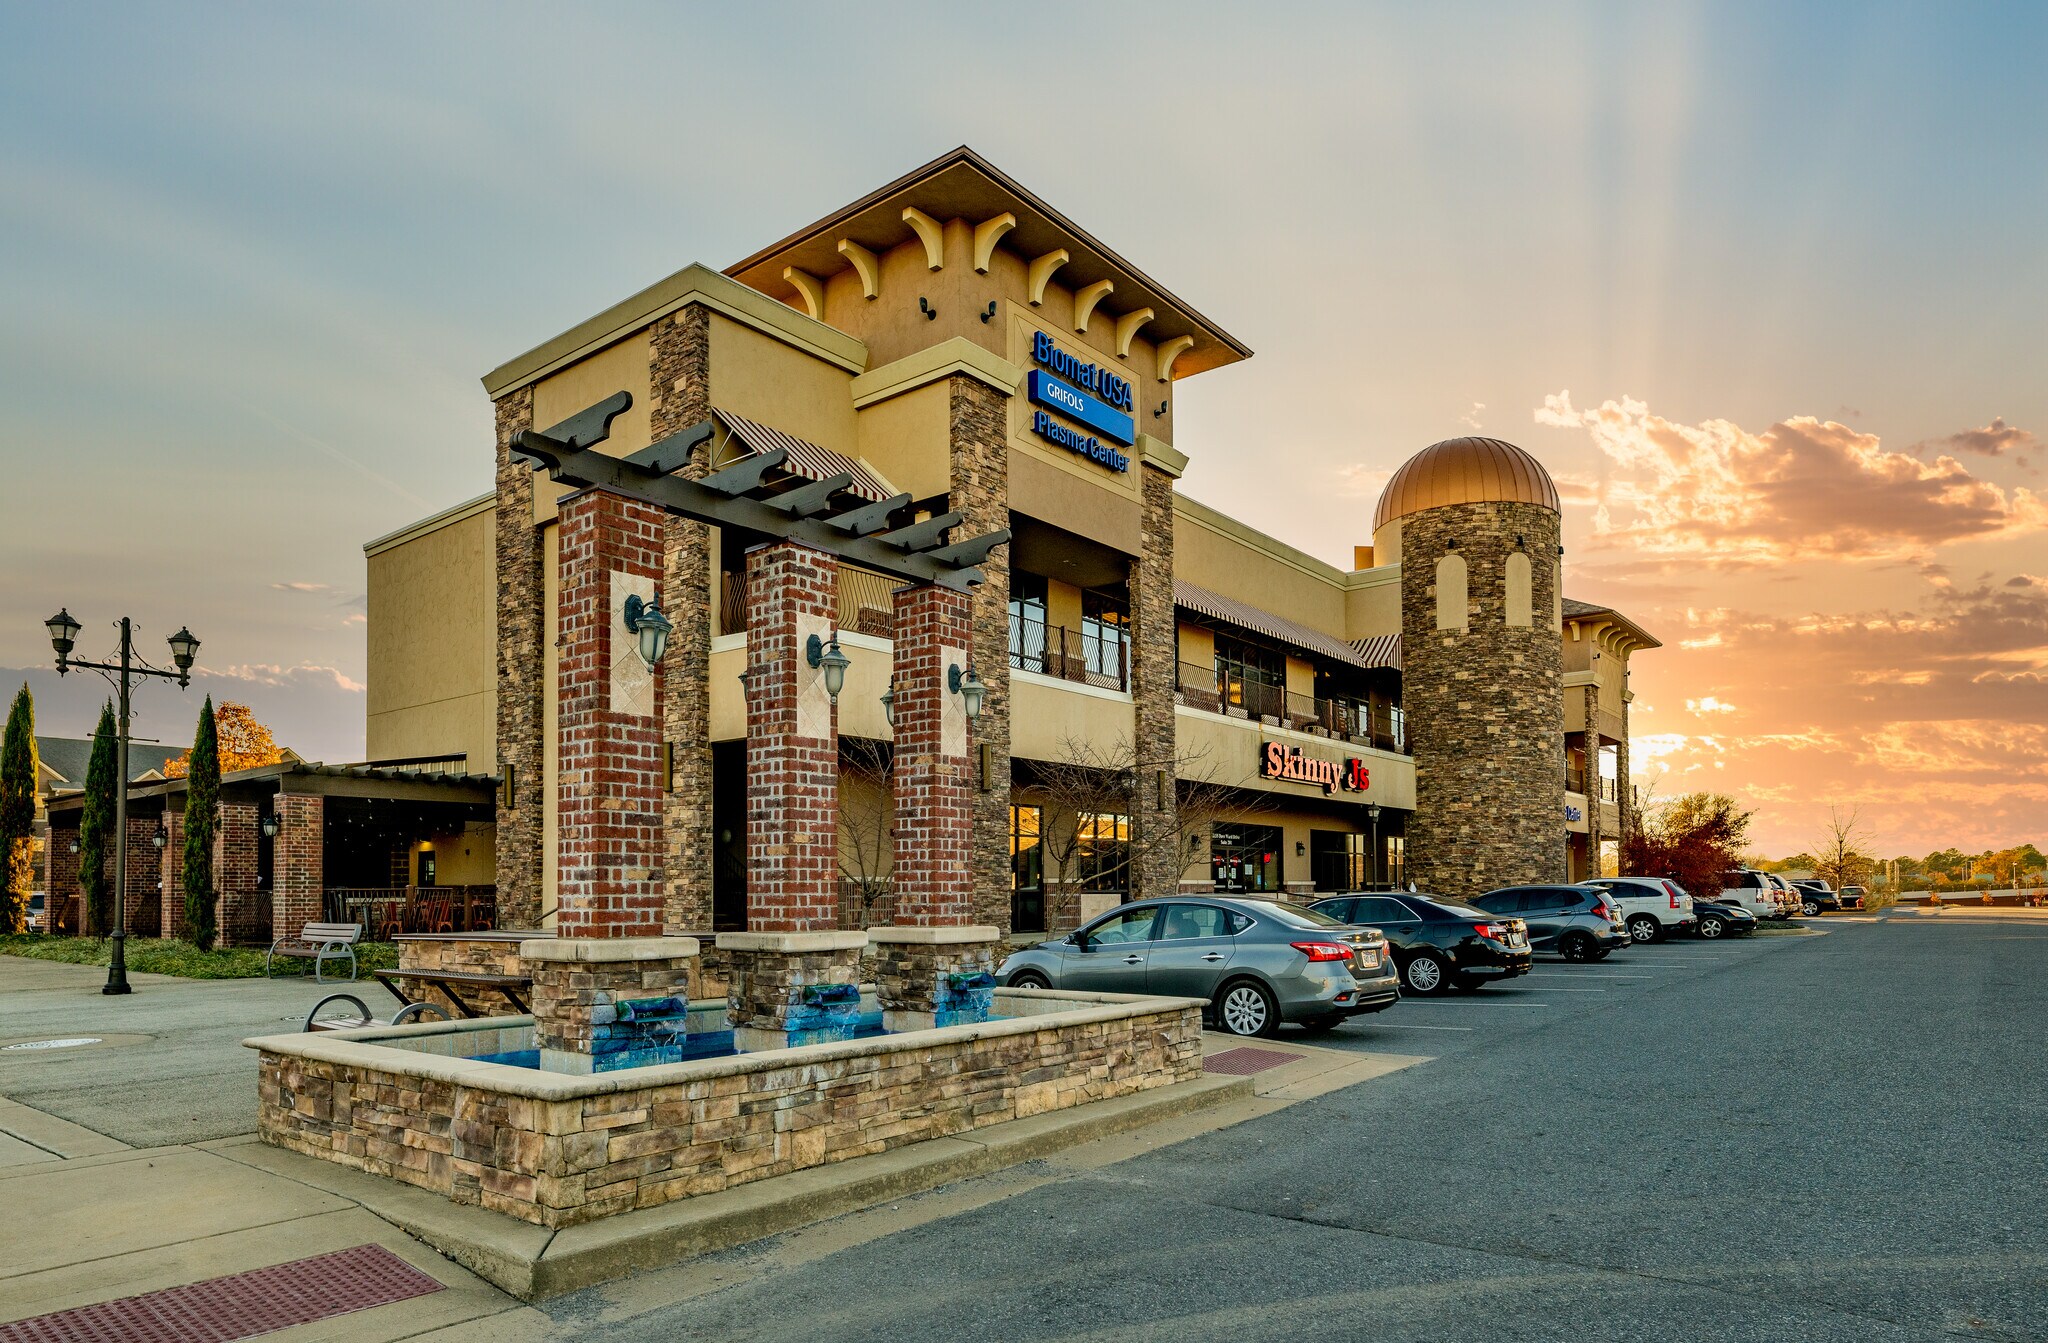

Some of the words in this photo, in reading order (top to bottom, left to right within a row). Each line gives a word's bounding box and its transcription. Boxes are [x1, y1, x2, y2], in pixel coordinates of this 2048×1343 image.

[1035, 331, 1097, 391] Biomat
[1099, 368, 1133, 412] USA
[1047, 383, 1084, 411] GRIFOLS
[1035, 411, 1087, 454] Plasma
[1088, 436, 1130, 472] Center
[1264, 741, 1343, 794] Skinny
